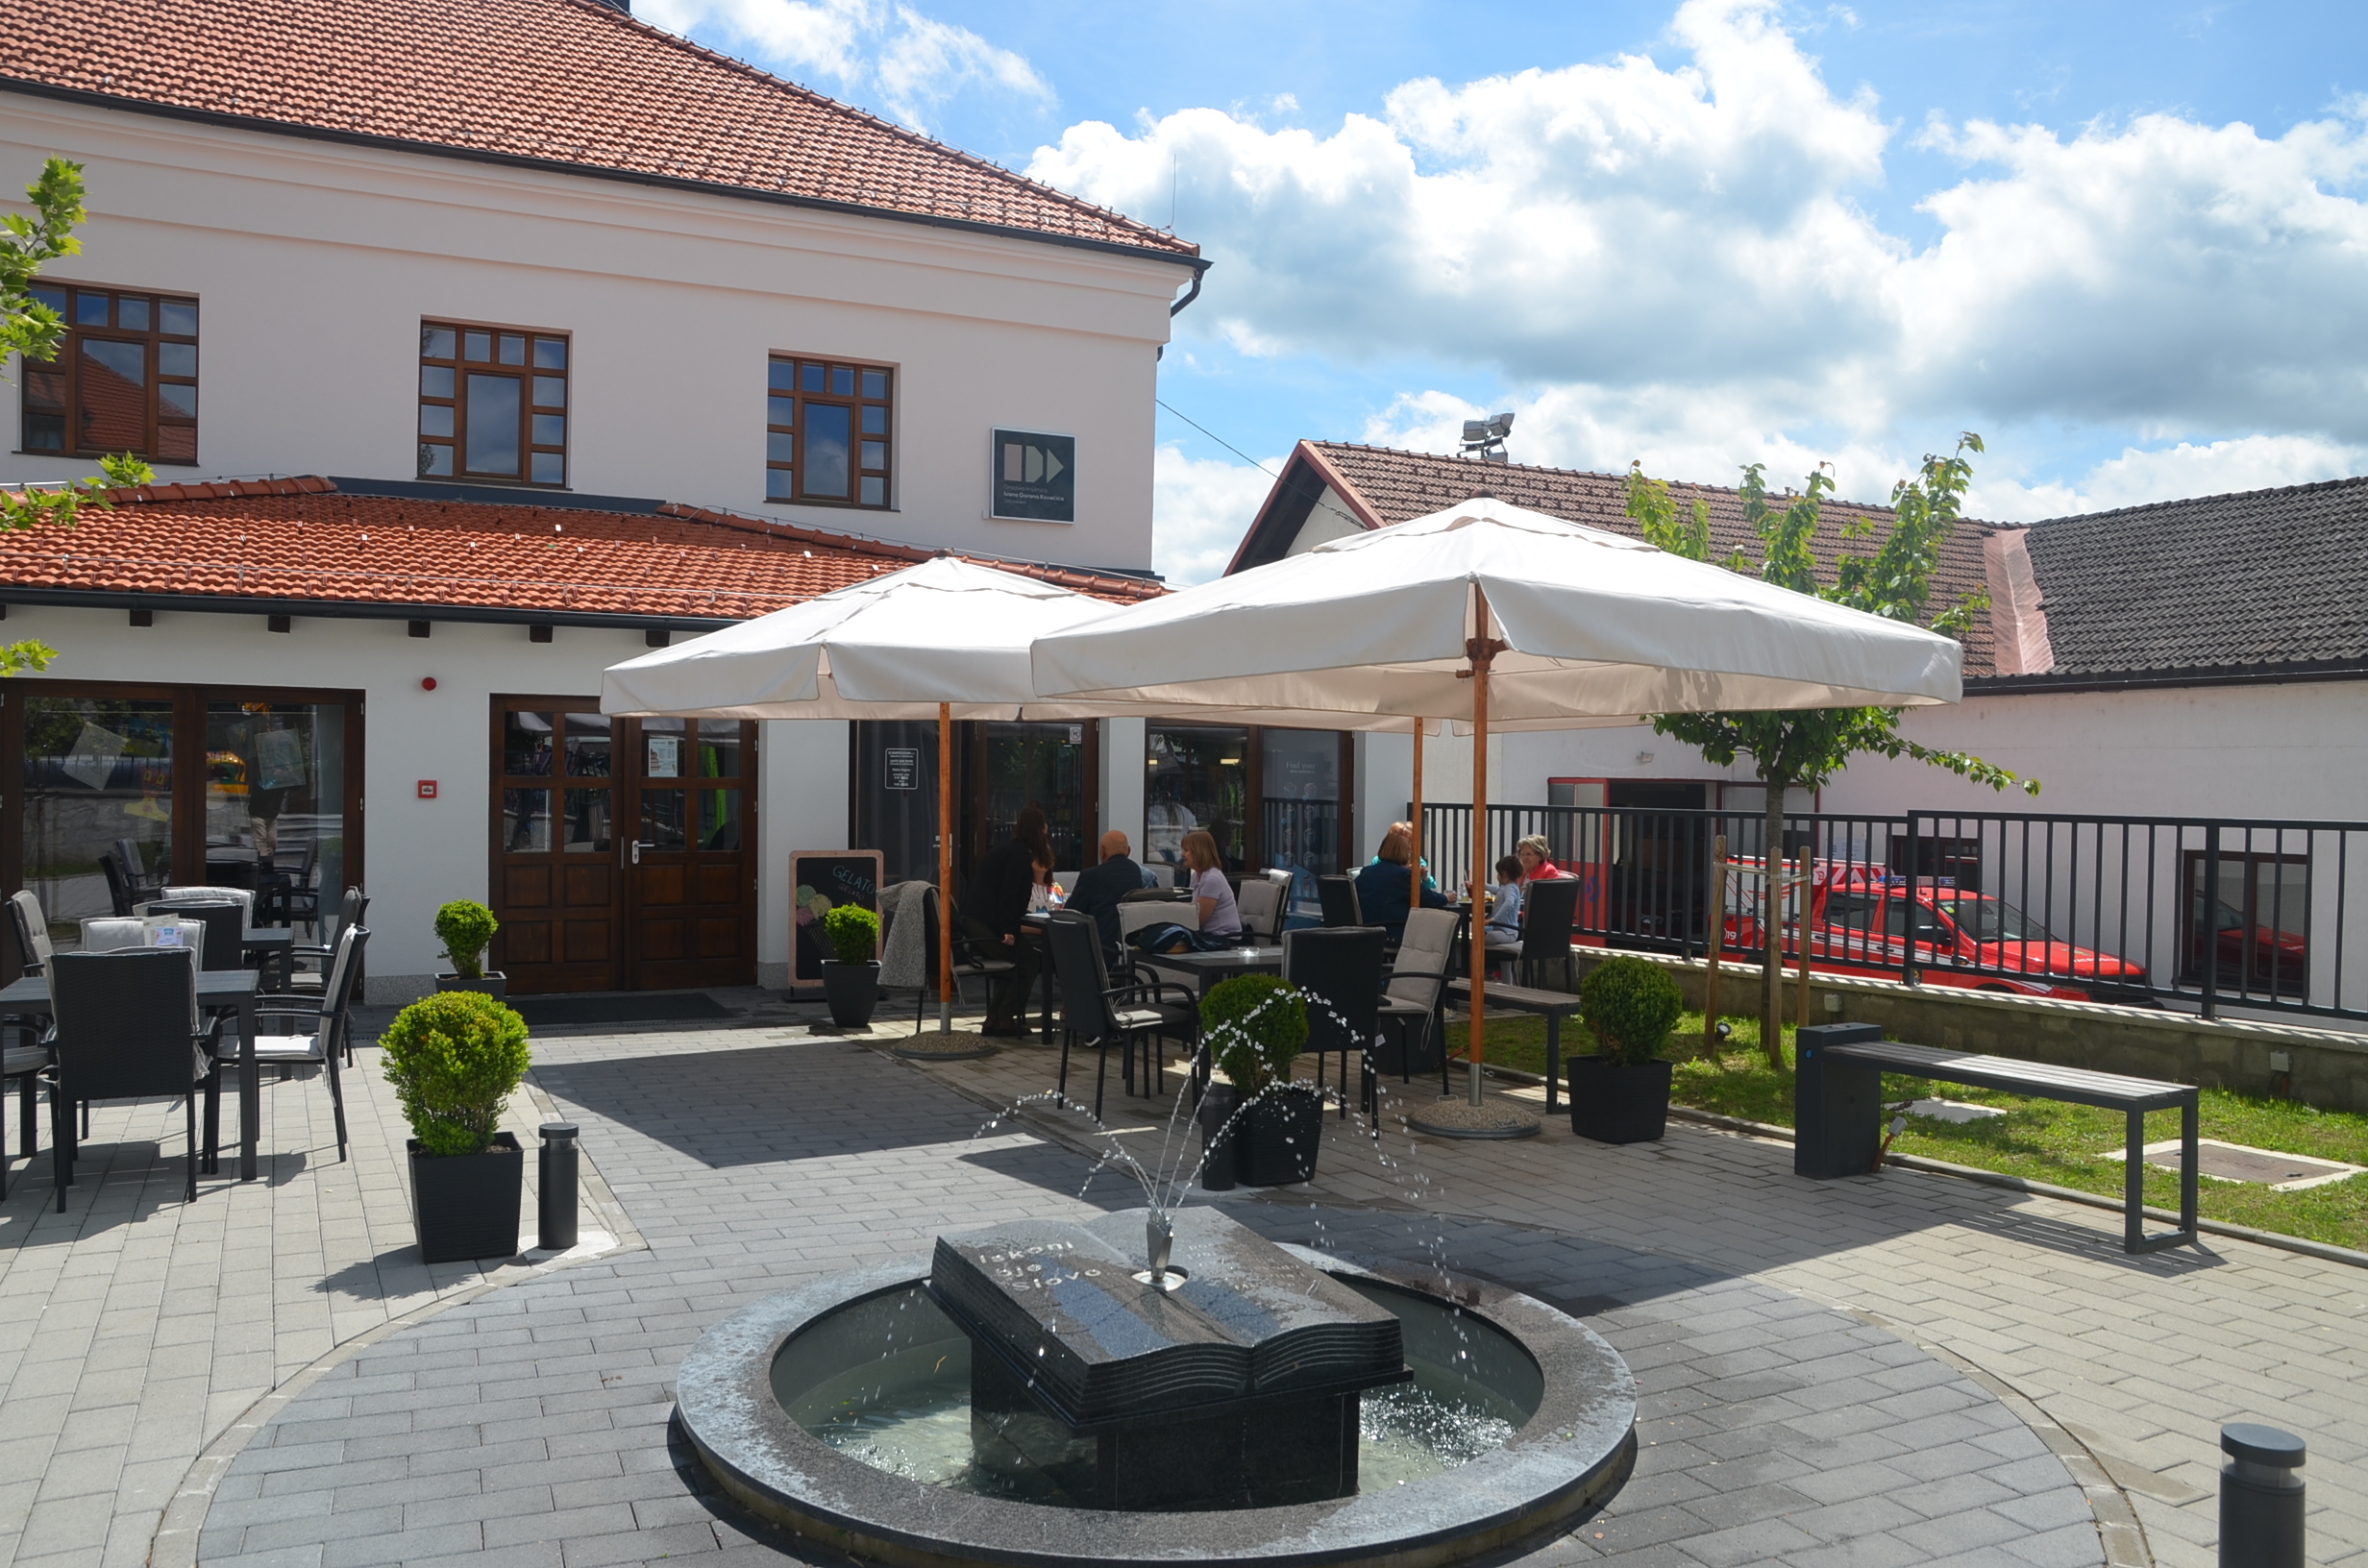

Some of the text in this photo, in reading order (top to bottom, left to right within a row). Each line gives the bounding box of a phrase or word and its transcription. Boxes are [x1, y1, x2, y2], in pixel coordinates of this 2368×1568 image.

[832, 865, 876, 894] GELATO
[837, 883, 865, 901] GELATO
[978, 1240, 1074, 1264] Iskoni
